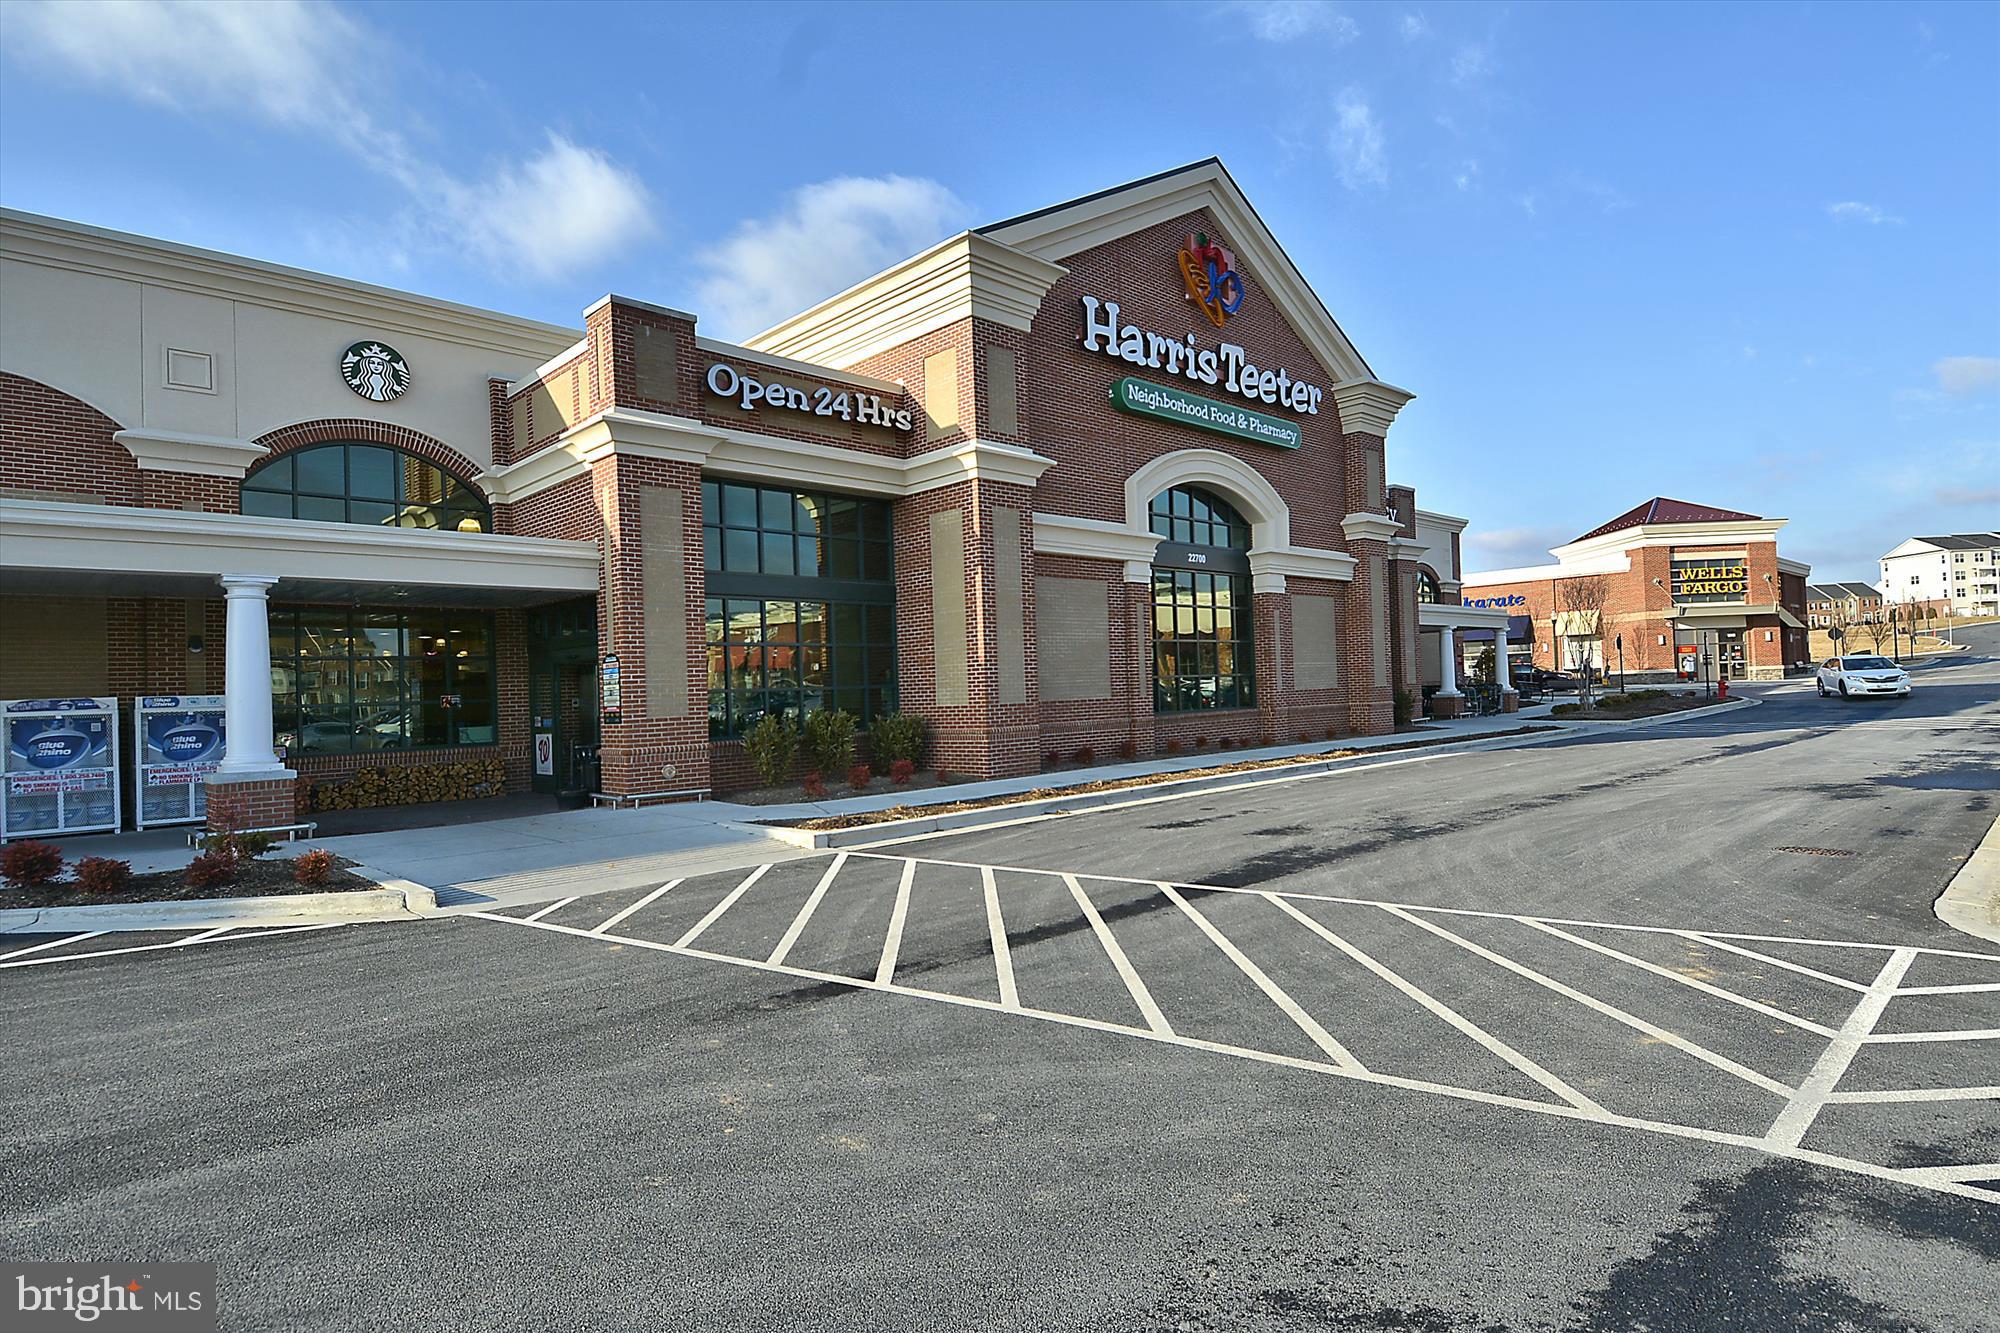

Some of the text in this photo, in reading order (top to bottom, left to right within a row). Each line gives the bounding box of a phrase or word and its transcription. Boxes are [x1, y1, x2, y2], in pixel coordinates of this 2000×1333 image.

[1082, 295, 1322, 415] Harris Teeter
[707, 363, 912, 431] Open 24 Hrs
[1127, 384, 1297, 444] Neighborhood Food & Pharmacy
[1187, 553, 1207, 564] 22700
[1680, 566, 1744, 580] WELLS
[1681, 580, 1743, 594] FARGO
[1463, 594, 1526, 608] karate
